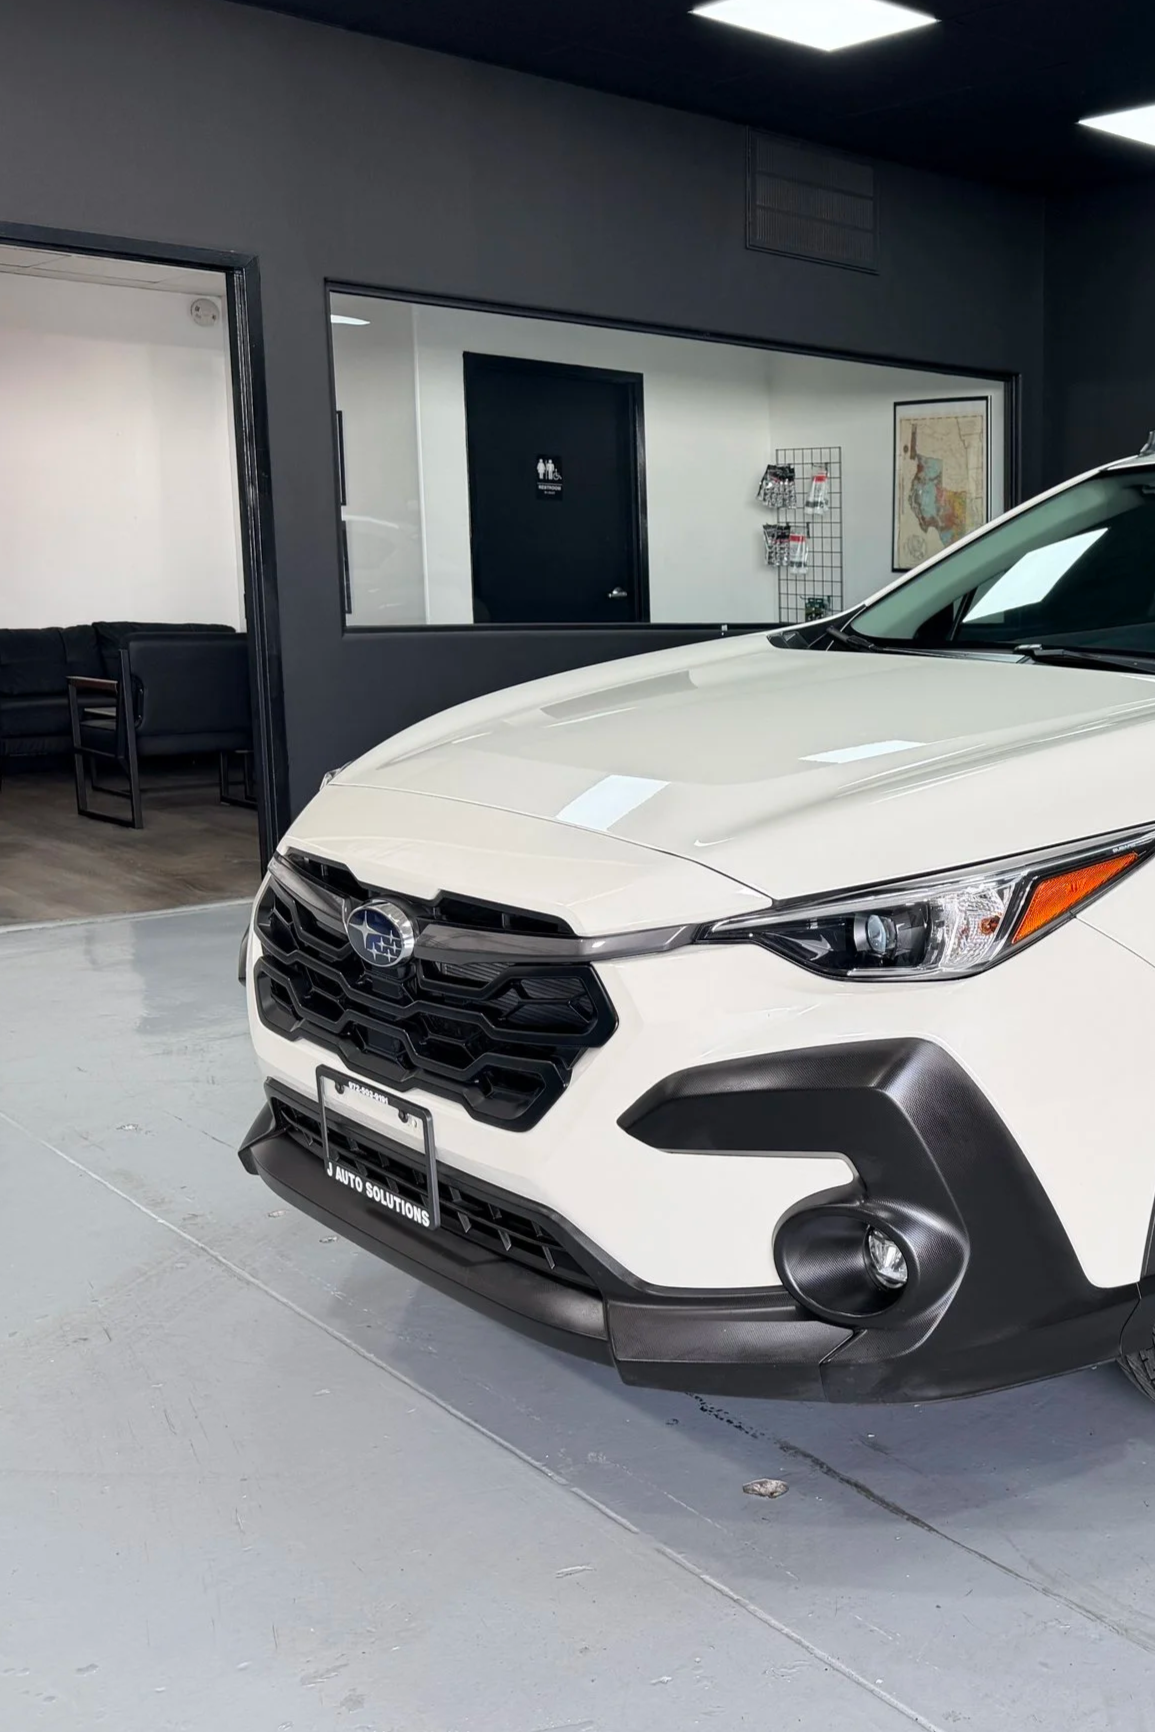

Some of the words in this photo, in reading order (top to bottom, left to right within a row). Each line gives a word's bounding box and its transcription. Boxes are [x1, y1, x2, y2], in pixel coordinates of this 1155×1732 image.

[327, 1162, 333, 1177] J
[335, 1165, 363, 1192] AUTO
[365, 1181, 431, 1228] SOLUTIONS
